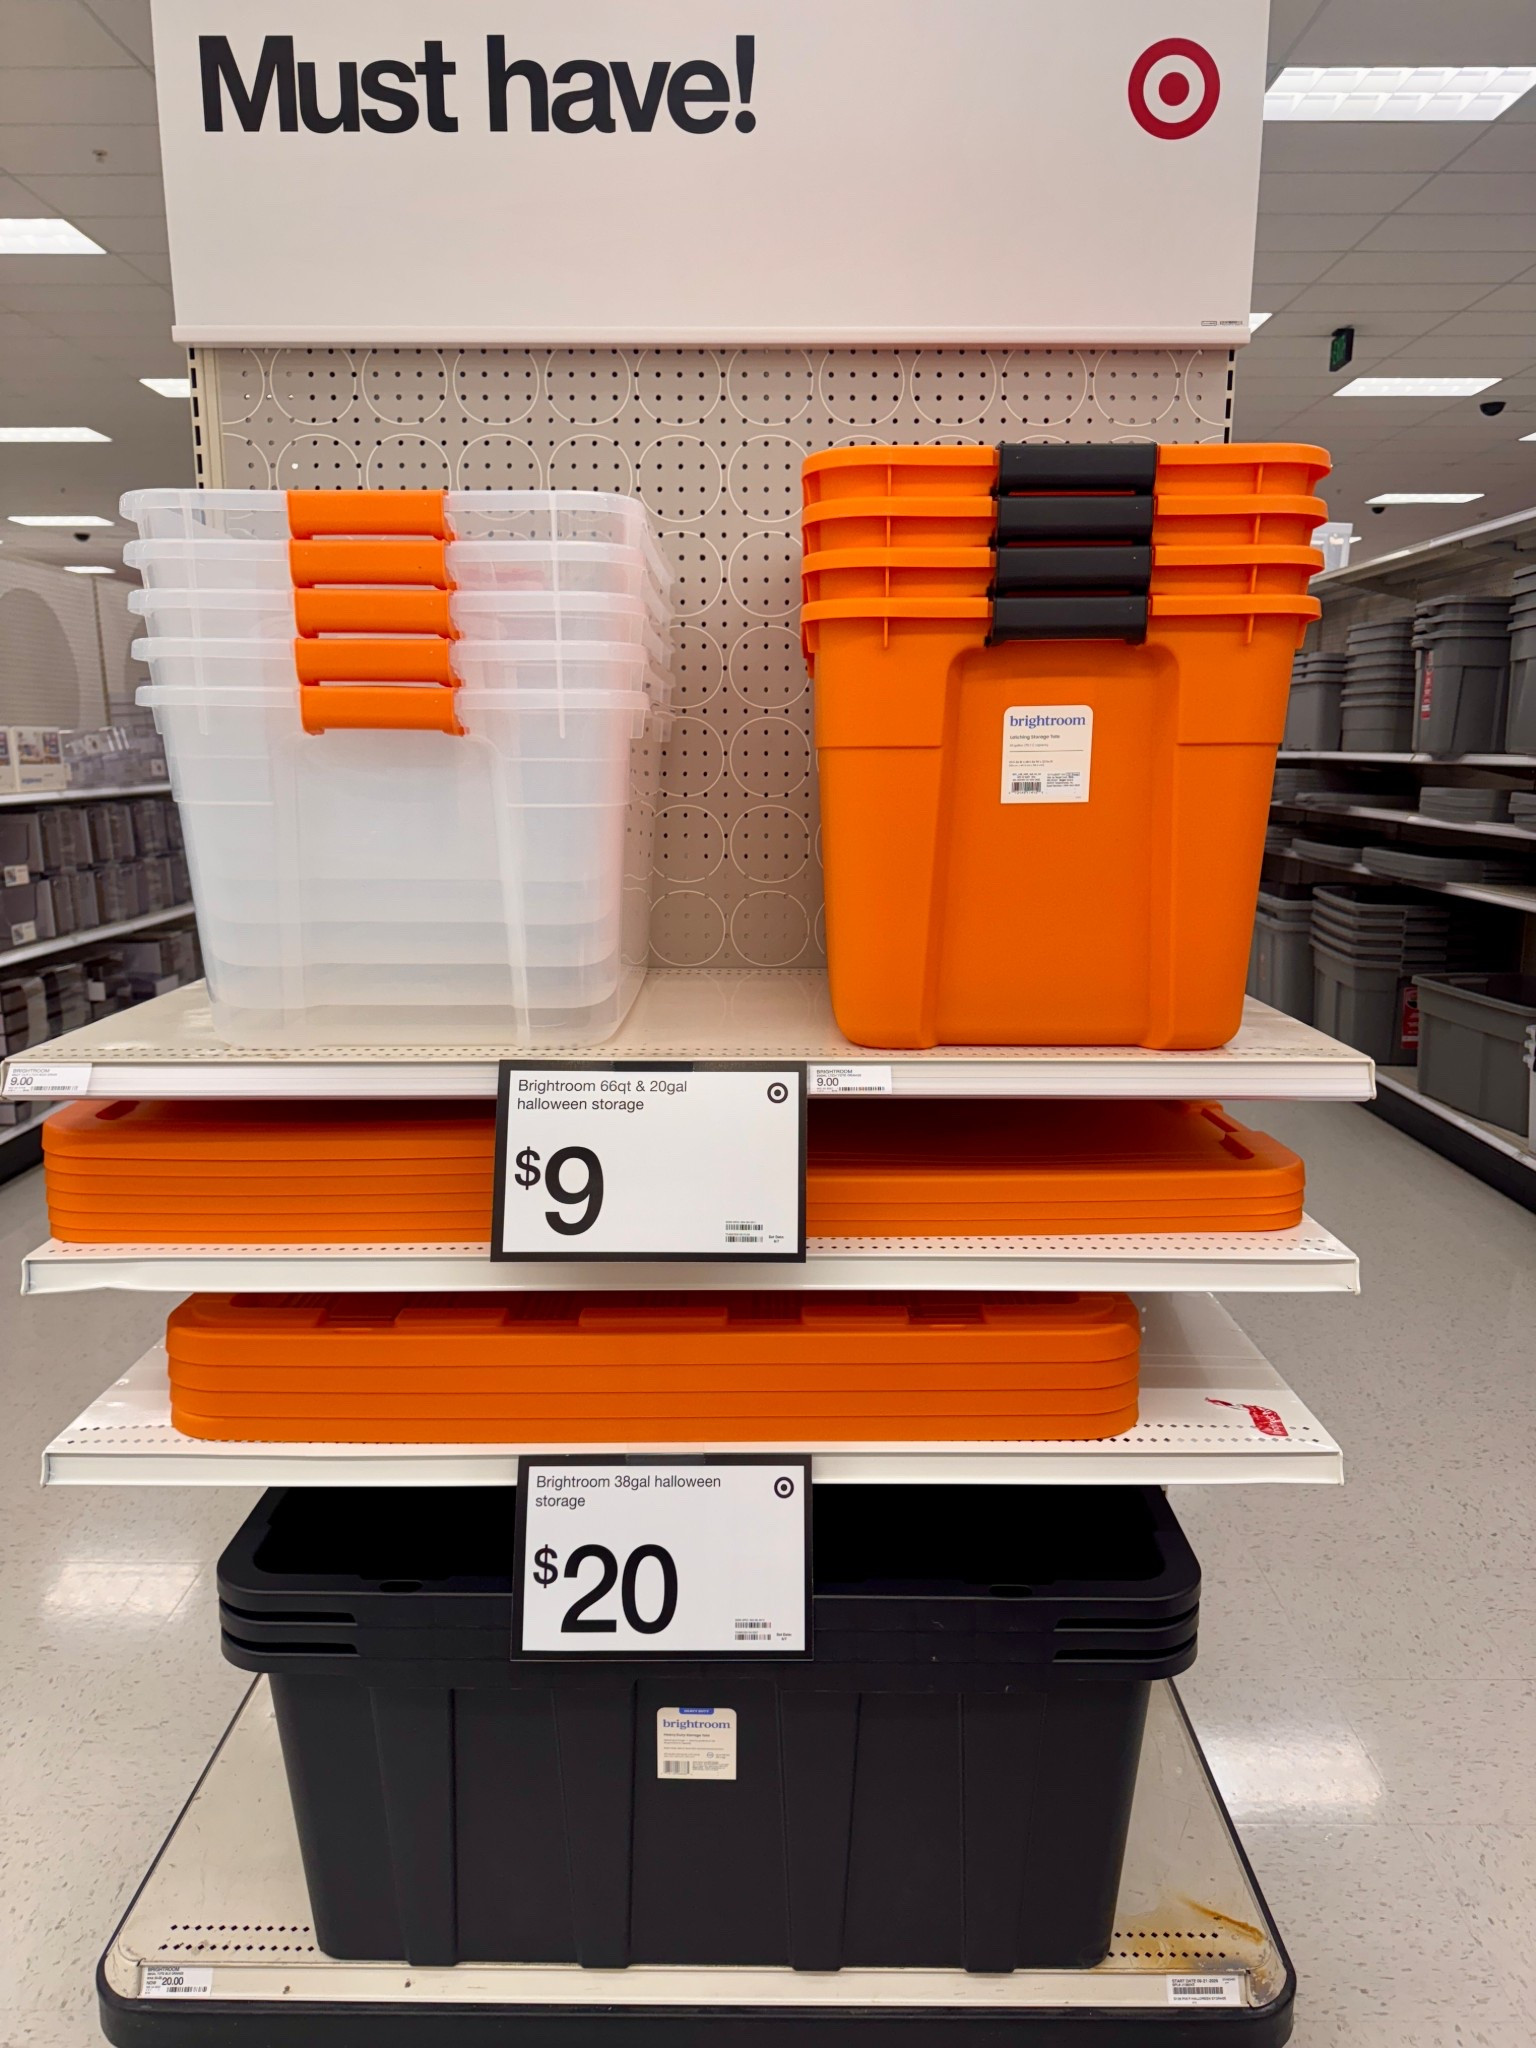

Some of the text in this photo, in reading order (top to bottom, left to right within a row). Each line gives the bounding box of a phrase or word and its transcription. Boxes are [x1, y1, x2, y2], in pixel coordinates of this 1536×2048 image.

[199, 34, 757, 134] Must have!
[1010, 715, 1085, 729] brightroom
[11, 1077, 33, 1086] 9.00
[518, 1079, 688, 1095] Brightroom 66qt & 20gal
[817, 1078, 839, 1086] 9.00
[517, 1097, 645, 1113] halloween storage
[514, 1145, 604, 1236] $9
[536, 1475, 721, 1491] Brightroom 38gal halloween
[535, 1496, 586, 1510] storage
[533, 1543, 678, 1635] $20
[663, 1719, 730, 1730] brightroom
[162, 1977, 184, 1985] 20.00
